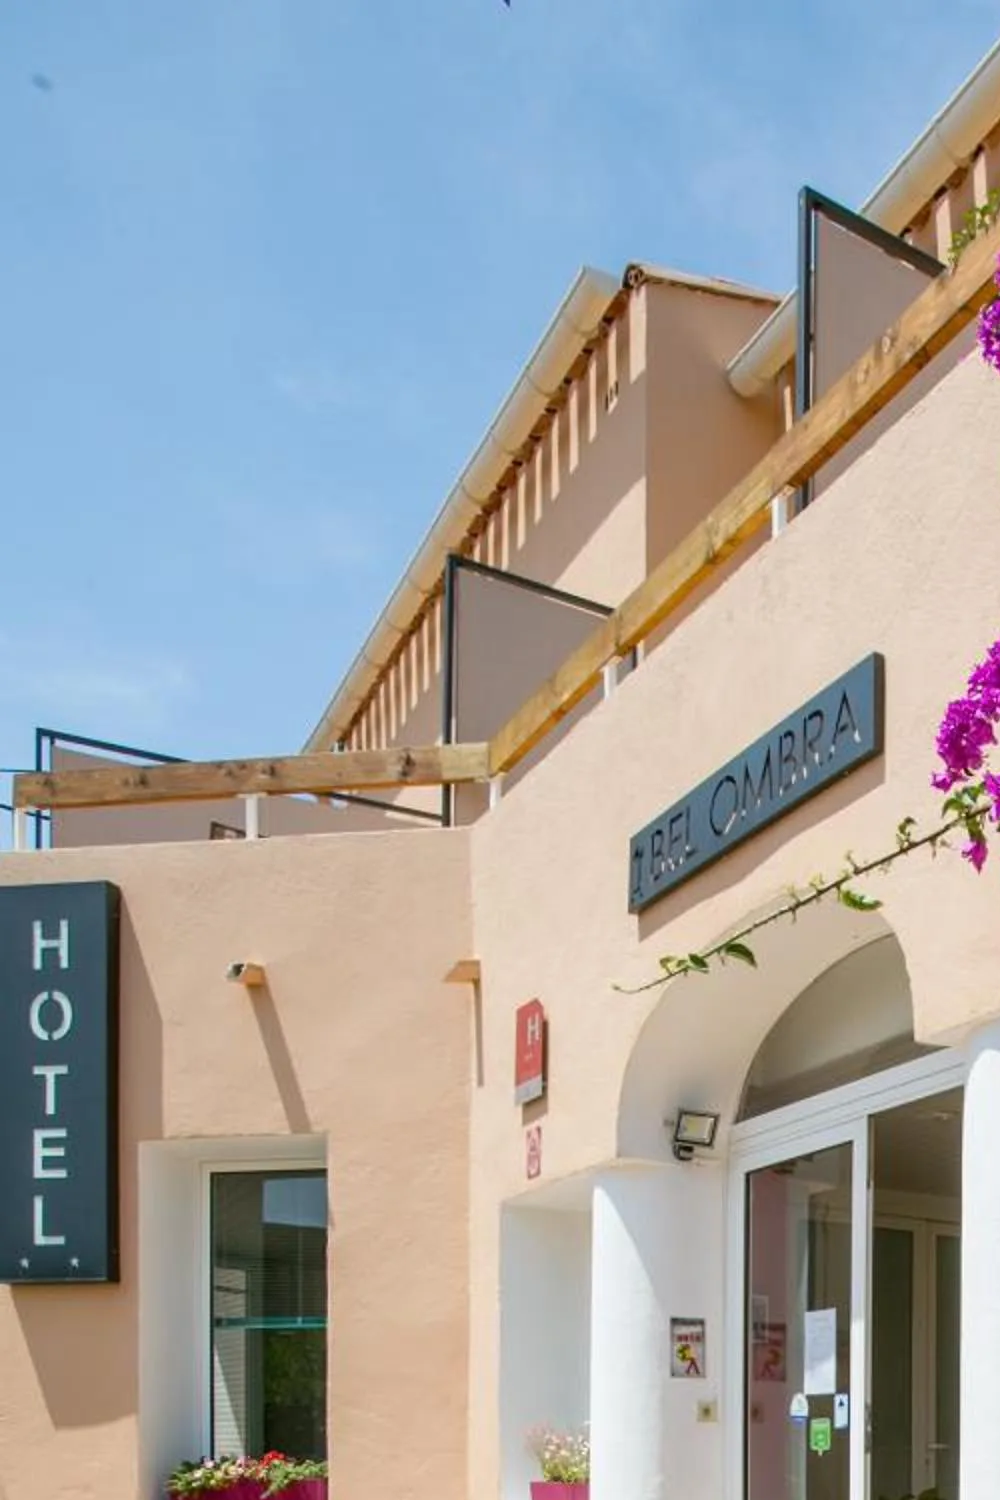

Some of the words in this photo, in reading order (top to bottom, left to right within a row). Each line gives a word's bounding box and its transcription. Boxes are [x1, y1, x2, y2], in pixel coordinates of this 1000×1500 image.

[708, 690, 862, 837] OMBRA
[29, 919, 74, 1246] HOTEL
[526, 1012, 541, 1046] H
